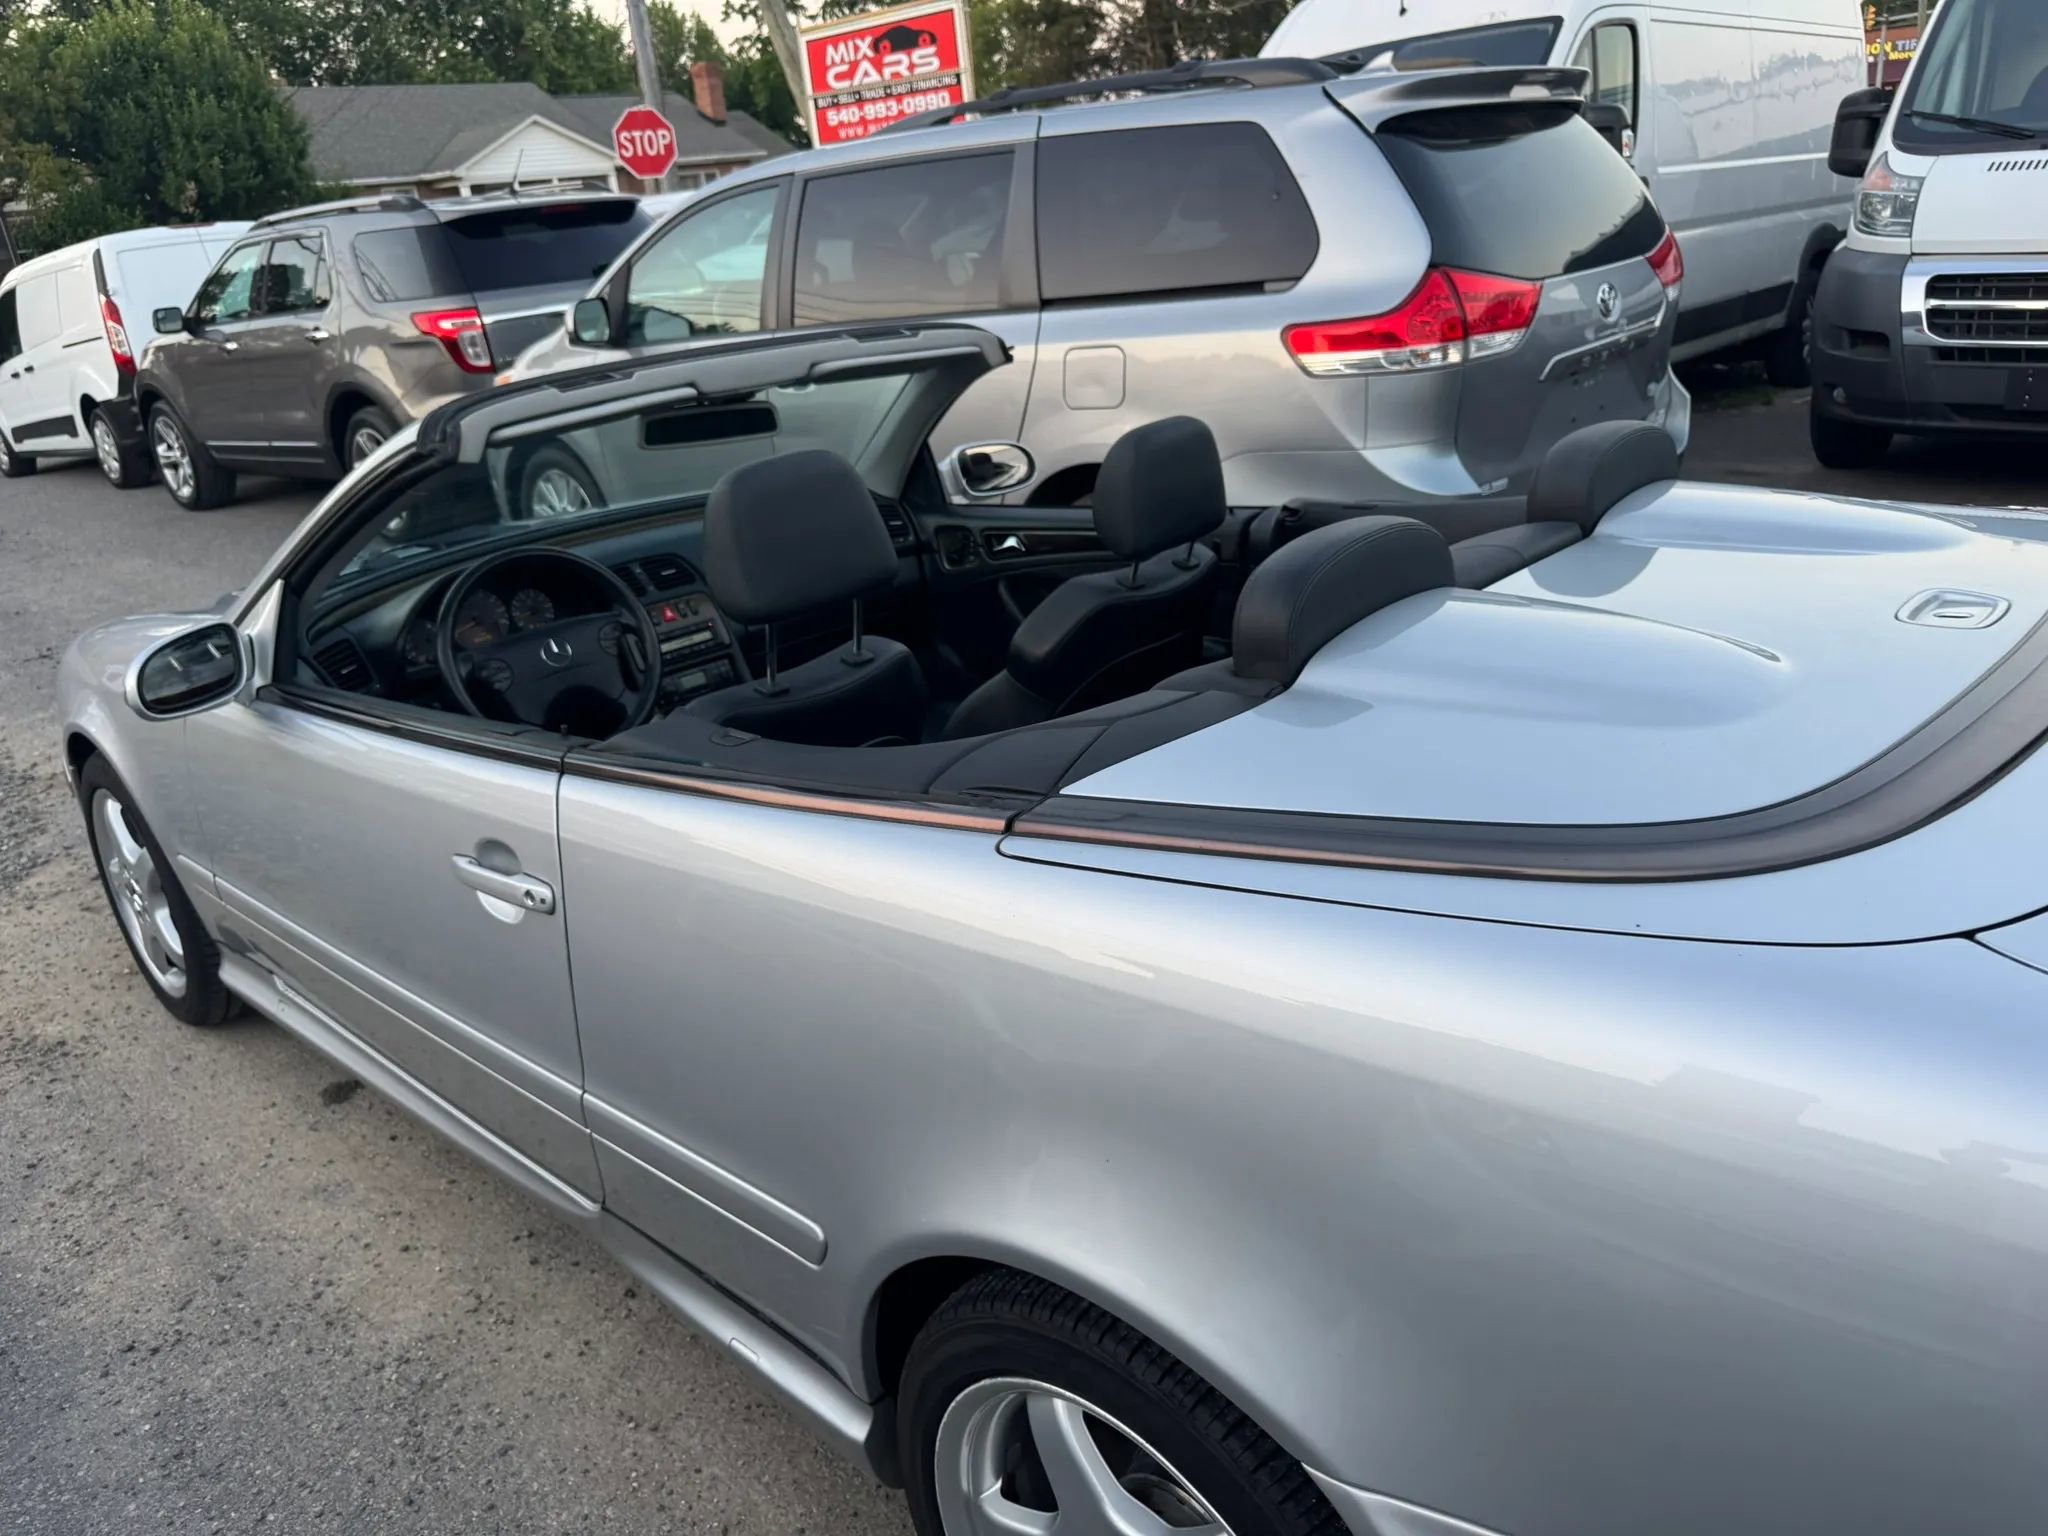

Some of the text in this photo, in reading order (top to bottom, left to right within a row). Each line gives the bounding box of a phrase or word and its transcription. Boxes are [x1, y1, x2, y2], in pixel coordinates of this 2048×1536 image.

[826, 36, 874, 66] MIX
[827, 47, 940, 88] CARS
[817, 97, 833, 108] BUY
[860, 87, 885, 100] TRADE
[912, 75, 957, 90] FINANCING
[827, 92, 951, 126] 540-993-0990
[619, 128, 671, 158] STOP
